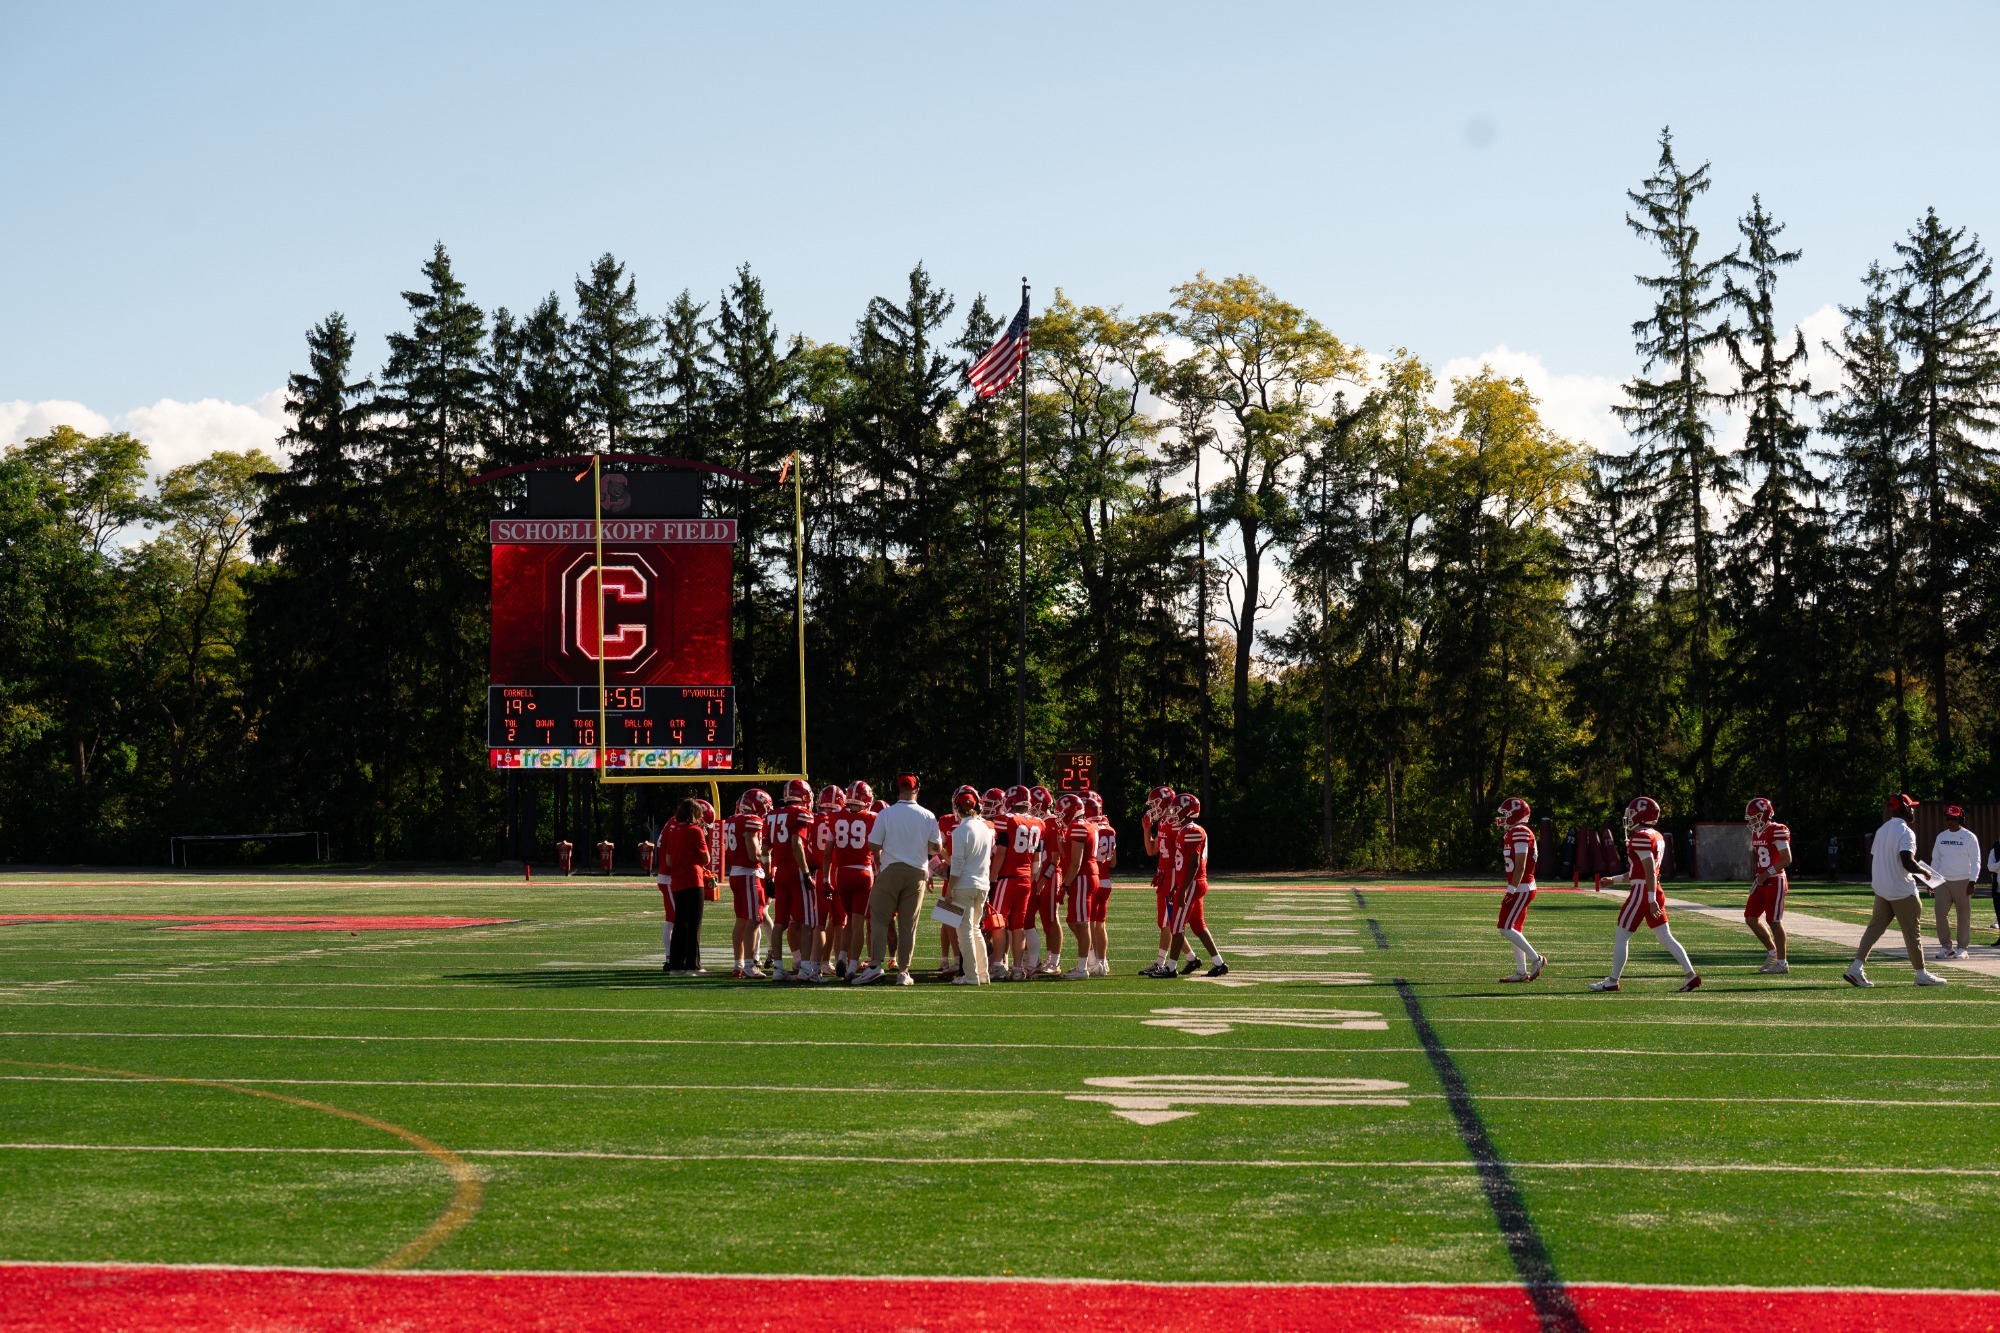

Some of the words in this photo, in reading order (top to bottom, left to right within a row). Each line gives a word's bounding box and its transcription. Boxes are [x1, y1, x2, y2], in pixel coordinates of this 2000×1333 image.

[498, 522, 657, 541] SCHOELLKOPF
[663, 522, 729, 540] FIELD
[575, 565, 648, 661] C
[503, 689, 534, 698] CORNELL
[506, 699, 522, 715] 19
[707, 699, 723, 715] 17
[504, 719, 518, 728] TOL
[535, 719, 555, 728] DOWN
[624, 719, 641, 728] BALL
[643, 719, 653, 728] ON
[669, 719, 686, 728] QTR
[704, 719, 718, 728] TOL
[507, 728, 515, 742] 2
[546, 729, 550, 745] 1
[579, 729, 594, 746] 10
[634, 730, 650, 745] 11
[672, 730, 683, 745] 4
[707, 728, 715, 742] 2
[1071, 755, 1092, 766] 1:56
[1062, 768, 1091, 790] 25
[1636, 800, 1648, 811] C
[766, 812, 789, 843] 73
[834, 818, 867, 850] 89
[1013, 824, 1041, 854] 60
[711, 822, 720, 873] CORNEL
